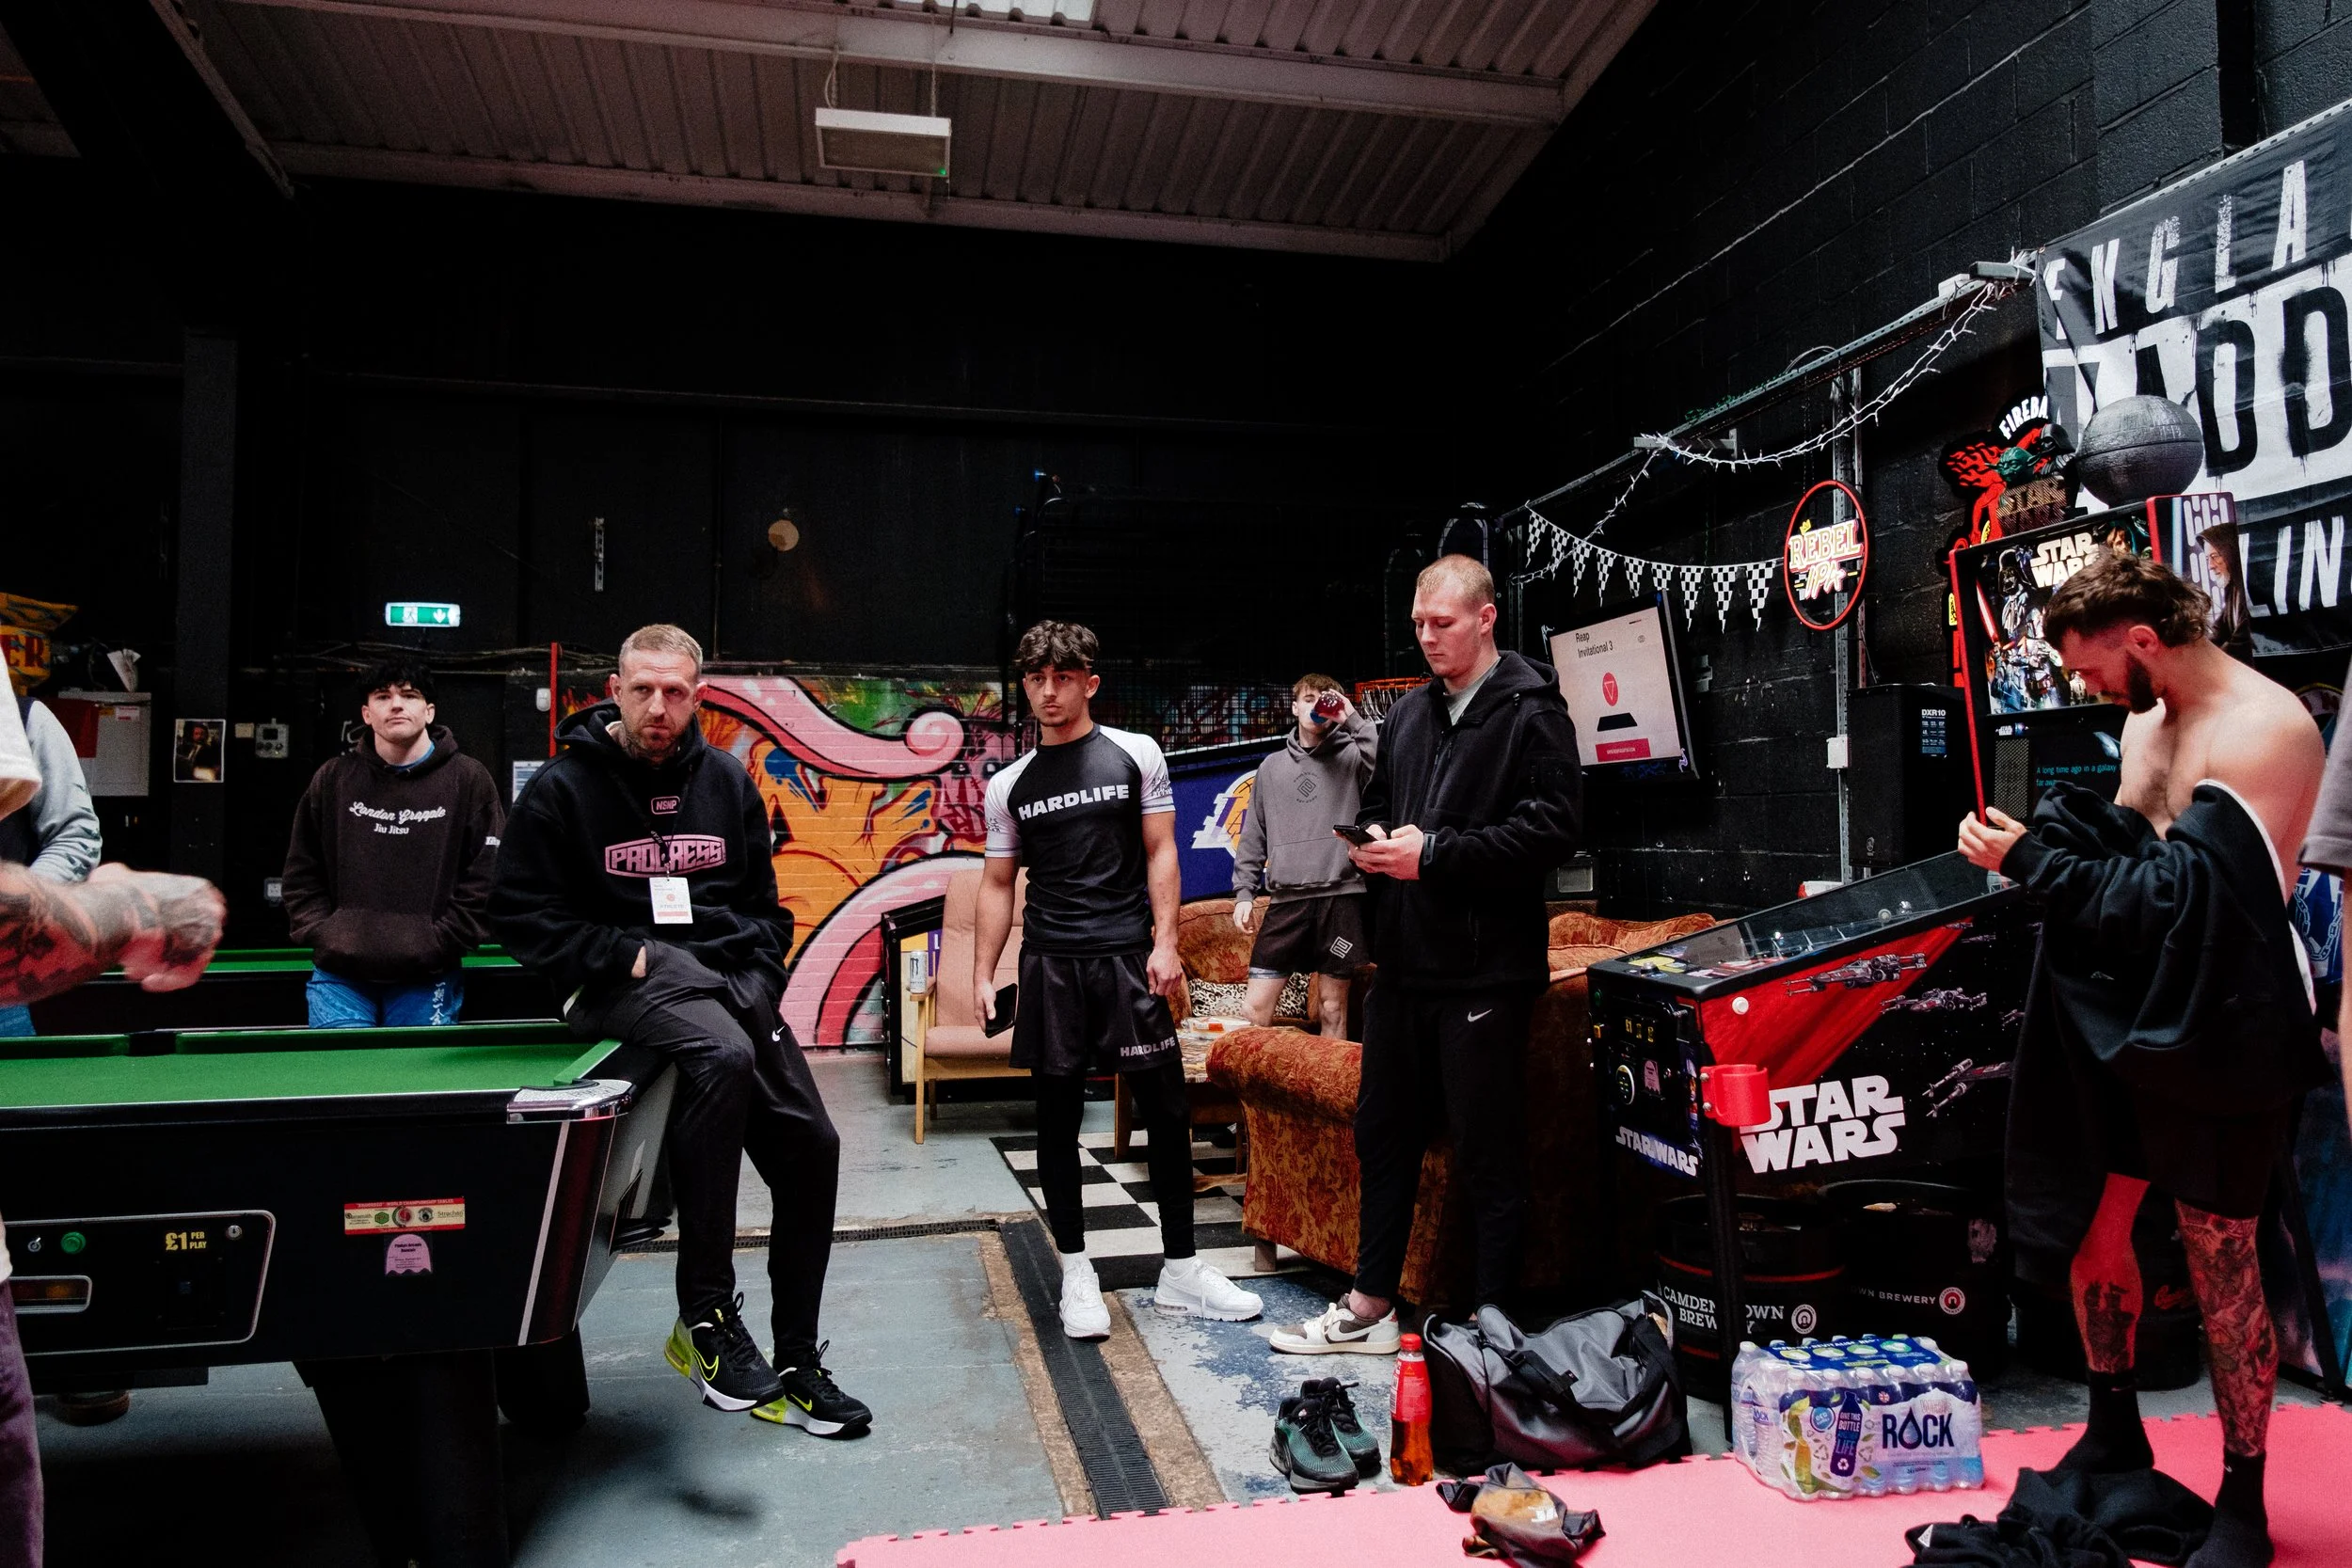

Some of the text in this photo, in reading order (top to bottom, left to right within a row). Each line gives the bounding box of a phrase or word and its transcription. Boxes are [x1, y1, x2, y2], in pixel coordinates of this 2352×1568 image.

[2042, 159, 2352, 341] ENGLA
[1789, 520, 1863, 568] REBEL
[2030, 532, 2099, 566] STAR
[2238, 515, 2352, 618] LIN
[1804, 561, 1846, 600] IPA
[1575, 632, 1590, 643] Reap
[1578, 641, 1613, 658] Invitational 3
[2042, 767, 2055, 775] long
[2071, 767, 2082, 775] ago
[2097, 764, 2117, 774] galaxy
[349, 801, 446, 825] London Grapple
[1018, 784, 1129, 821] HARDLIFE
[373, 823, 409, 835] Jiu Jitsu
[1120, 1037, 1176, 1057] HARDLIFE
[1740, 1074, 1904, 1133] STAR
[1615, 1126, 1698, 1177] STAR WARS
[1740, 1112, 1906, 1174] WARS
[166, 1231, 205, 1250] £1 PER
[1878, 1291, 1936, 1306] BREWERY
[1745, 1304, 1785, 1320] OWN
[1838, 1419, 1861, 1432] BOTTLE
[1883, 1407, 1955, 1449] ROCK
[1835, 1438, 1856, 1456] LIFE
